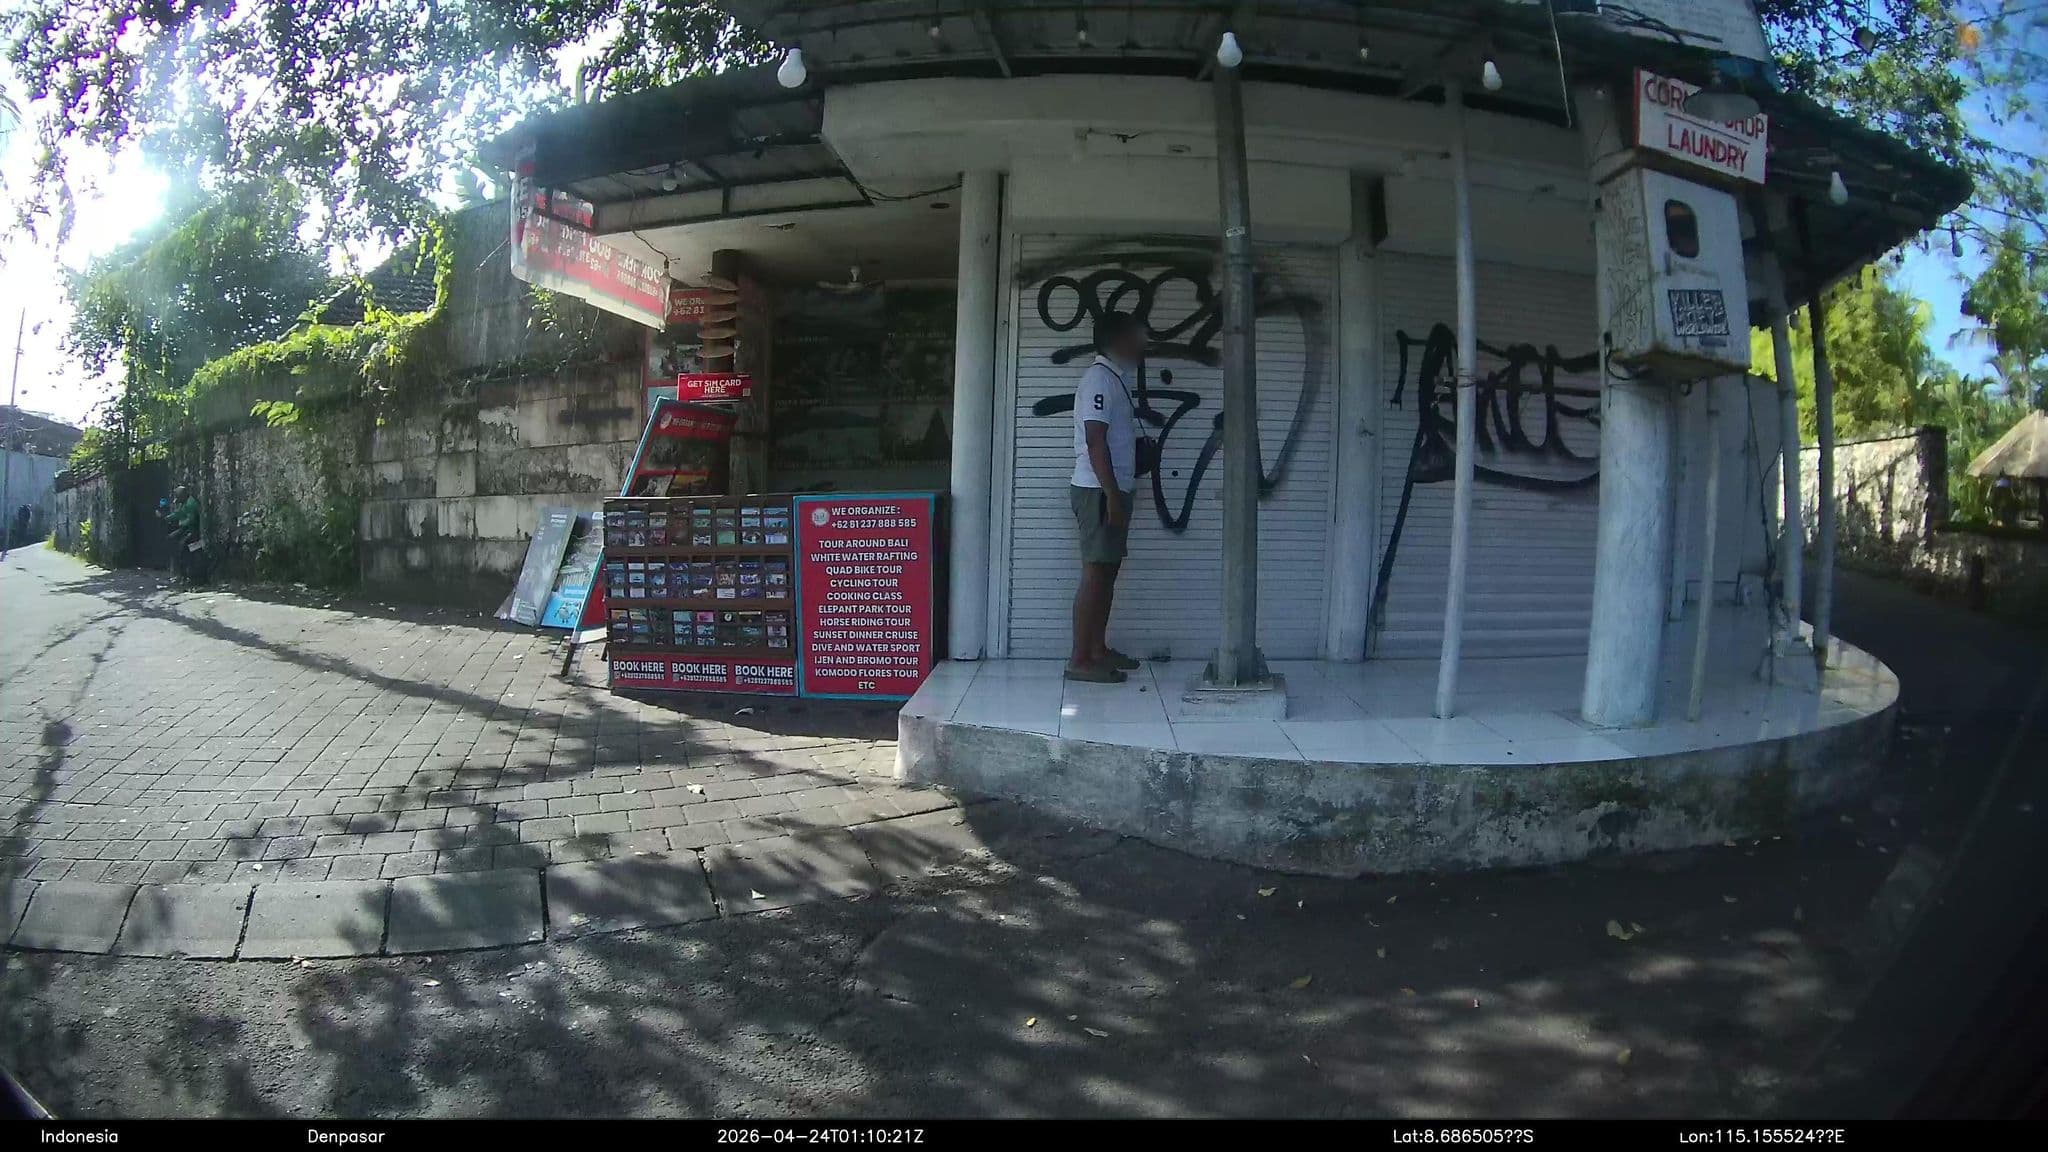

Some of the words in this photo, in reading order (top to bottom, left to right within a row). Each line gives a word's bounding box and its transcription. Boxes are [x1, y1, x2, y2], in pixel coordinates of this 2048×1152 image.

[1667, 123, 1748, 173] LAUNDRY
[674, 298, 688, 306] WE
[687, 380, 702, 388] GET
[704, 386, 725, 394] HERE
[1094, 393, 1104, 410] 9
[832, 507, 846, 516] WE
[832, 520, 848, 529] +62
[850, 520, 859, 528] 81
[861, 520, 876, 528] 237
[878, 519, 896, 528] 888
[898, 519, 917, 527] 585
[819, 540, 844, 549] TOUR
[846, 539, 886, 548] AROUND
[888, 539, 908, 547] BALI
[811, 553, 841, 562] WHITE
[842, 553, 875, 561] WATER
[877, 552, 918, 561] RAFTING
[826, 566, 853, 575] QUAD
[855, 566, 875, 574] BIKE
[877, 566, 903, 574] TOUR
[830, 579, 871, 587] CYCLING
[872, 579, 898, 587] TOUR
[827, 592, 871, 600] COOKING
[873, 592, 902, 600] CLASS
[818, 605, 857, 613] ELEPANT
[859, 605, 884, 613] PARK
[886, 605, 911, 613] TOUR
[820, 618, 850, 626] HORSE
[852, 618, 883, 626] RIDING
[885, 618, 911, 626] TOUR
[813, 631, 848, 639] SUNSET
[849, 631, 884, 639] DINNER
[885, 631, 918, 639] CRUISE
[834, 644, 854, 652] AND
[855, 644, 888, 652] WATER
[891, 644, 920, 652] SPORT
[815, 656, 834, 664] IJEN
[835, 656, 855, 664] AND
[857, 657, 892, 665] BROMO
[894, 657, 918, 665] TOUR
[613, 661, 639, 671] BOOK
[641, 662, 664, 672] HERE
[672, 663, 700, 674] BOOK
[702, 664, 726, 674] HERE
[735, 665, 765, 676] BOOK
[767, 666, 793, 677] HERE
[815, 669, 857, 677] KOMODO
[859, 669, 891, 677] FLORES
[894, 670, 918, 678] TOUR
[858, 682, 875, 690] ETC
